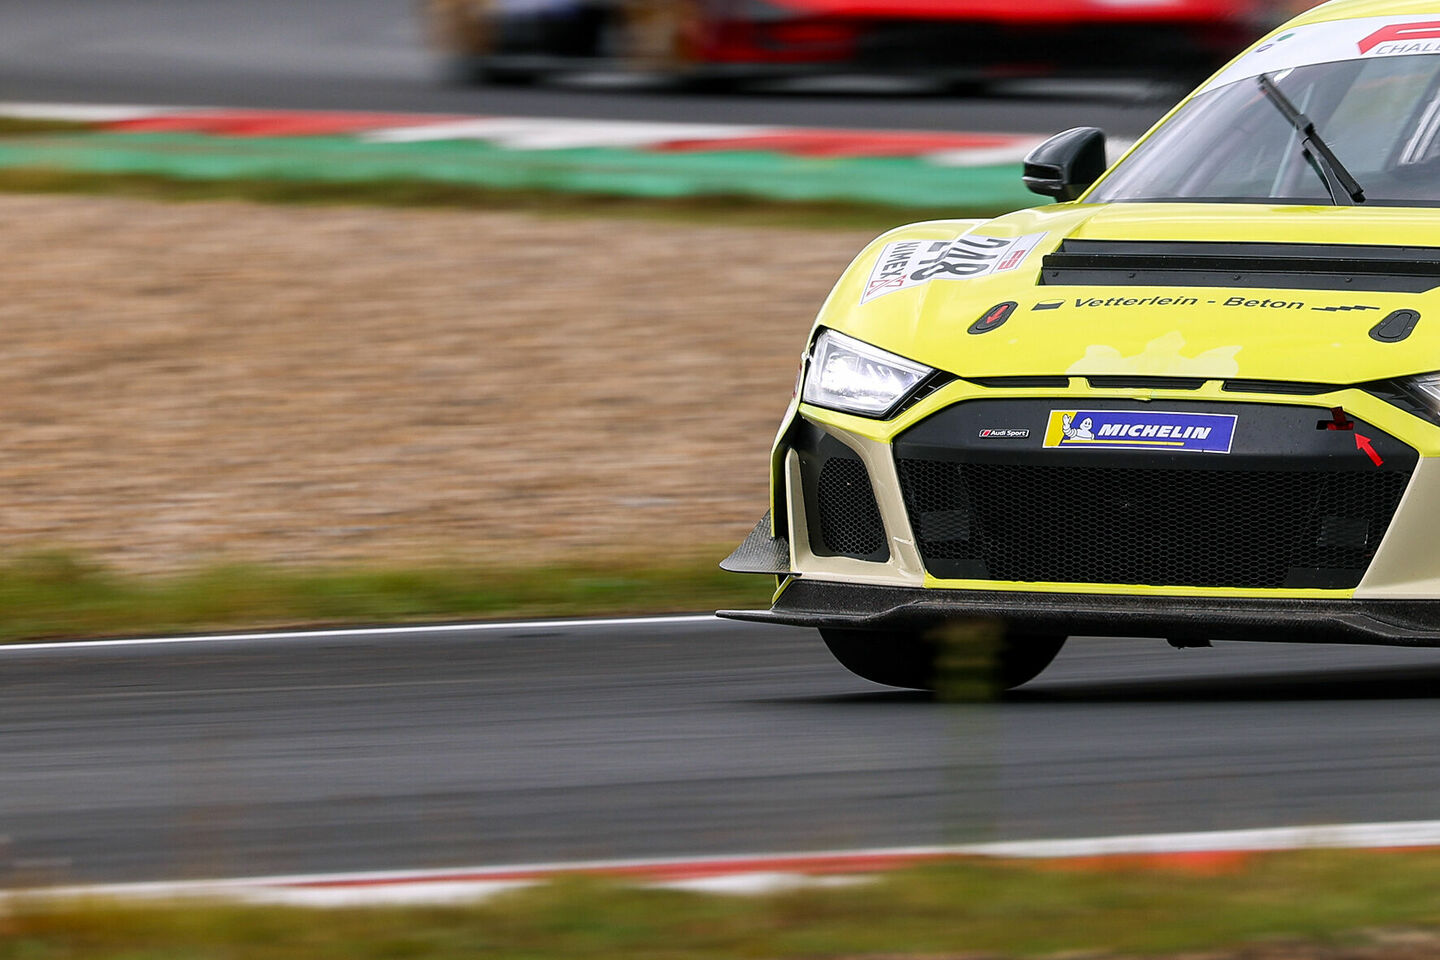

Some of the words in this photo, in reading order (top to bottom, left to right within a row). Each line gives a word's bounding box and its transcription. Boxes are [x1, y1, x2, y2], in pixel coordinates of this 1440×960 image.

[1074, 295, 1198, 309] Vetterlein
[1222, 296, 1305, 310] Beton
[1097, 423, 1212, 439] MICHELIN
